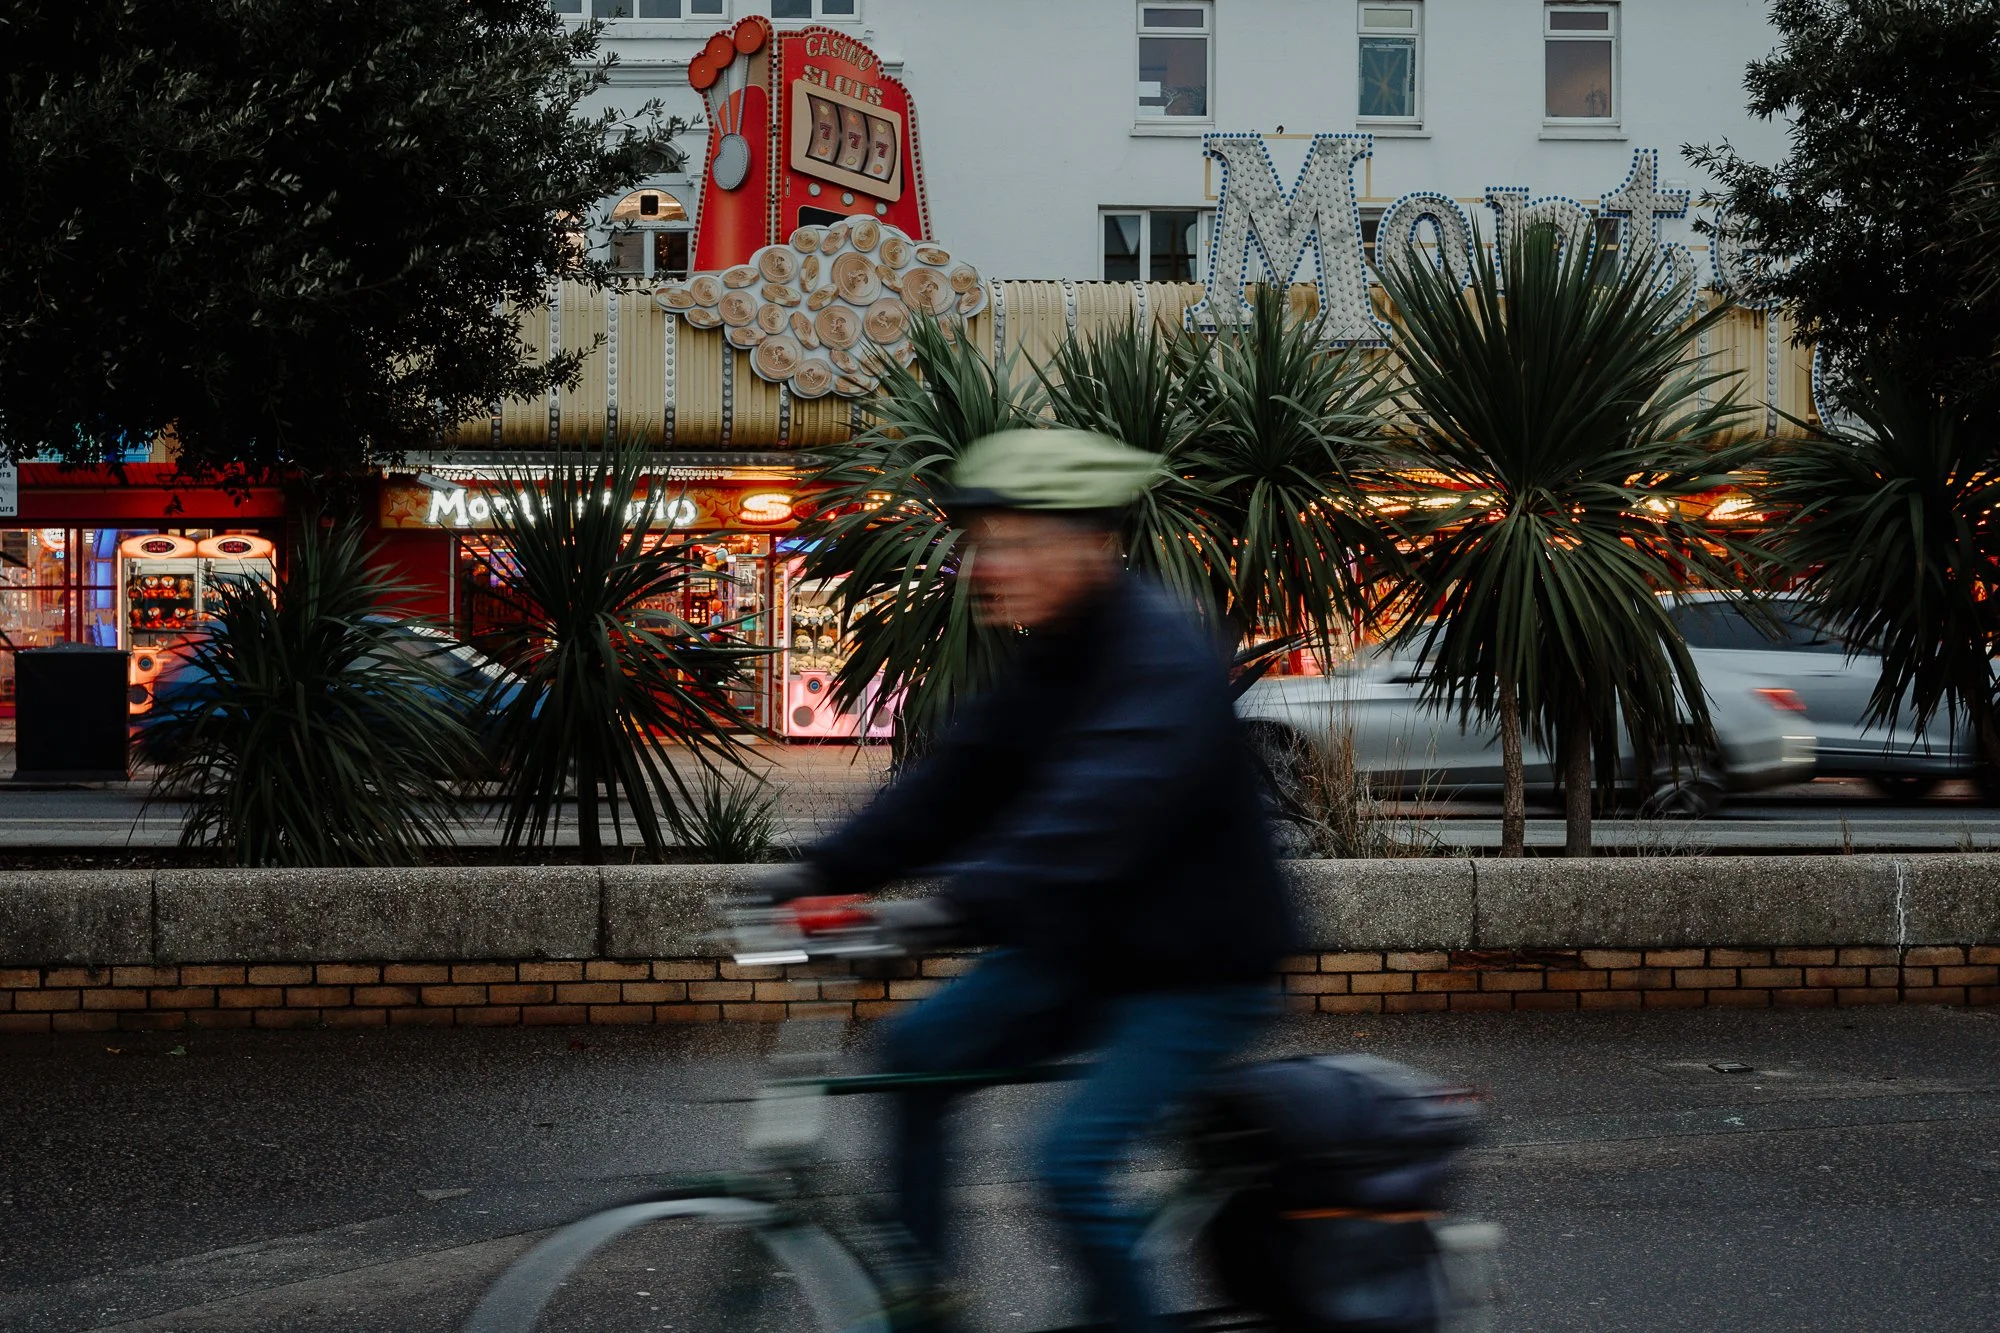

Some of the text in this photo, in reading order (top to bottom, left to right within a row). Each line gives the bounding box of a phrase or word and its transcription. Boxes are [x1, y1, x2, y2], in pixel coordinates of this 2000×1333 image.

[805, 36, 874, 72] CASINO
[802, 64, 884, 107] SLOTS
[819, 122, 889, 159] 7 7 7
